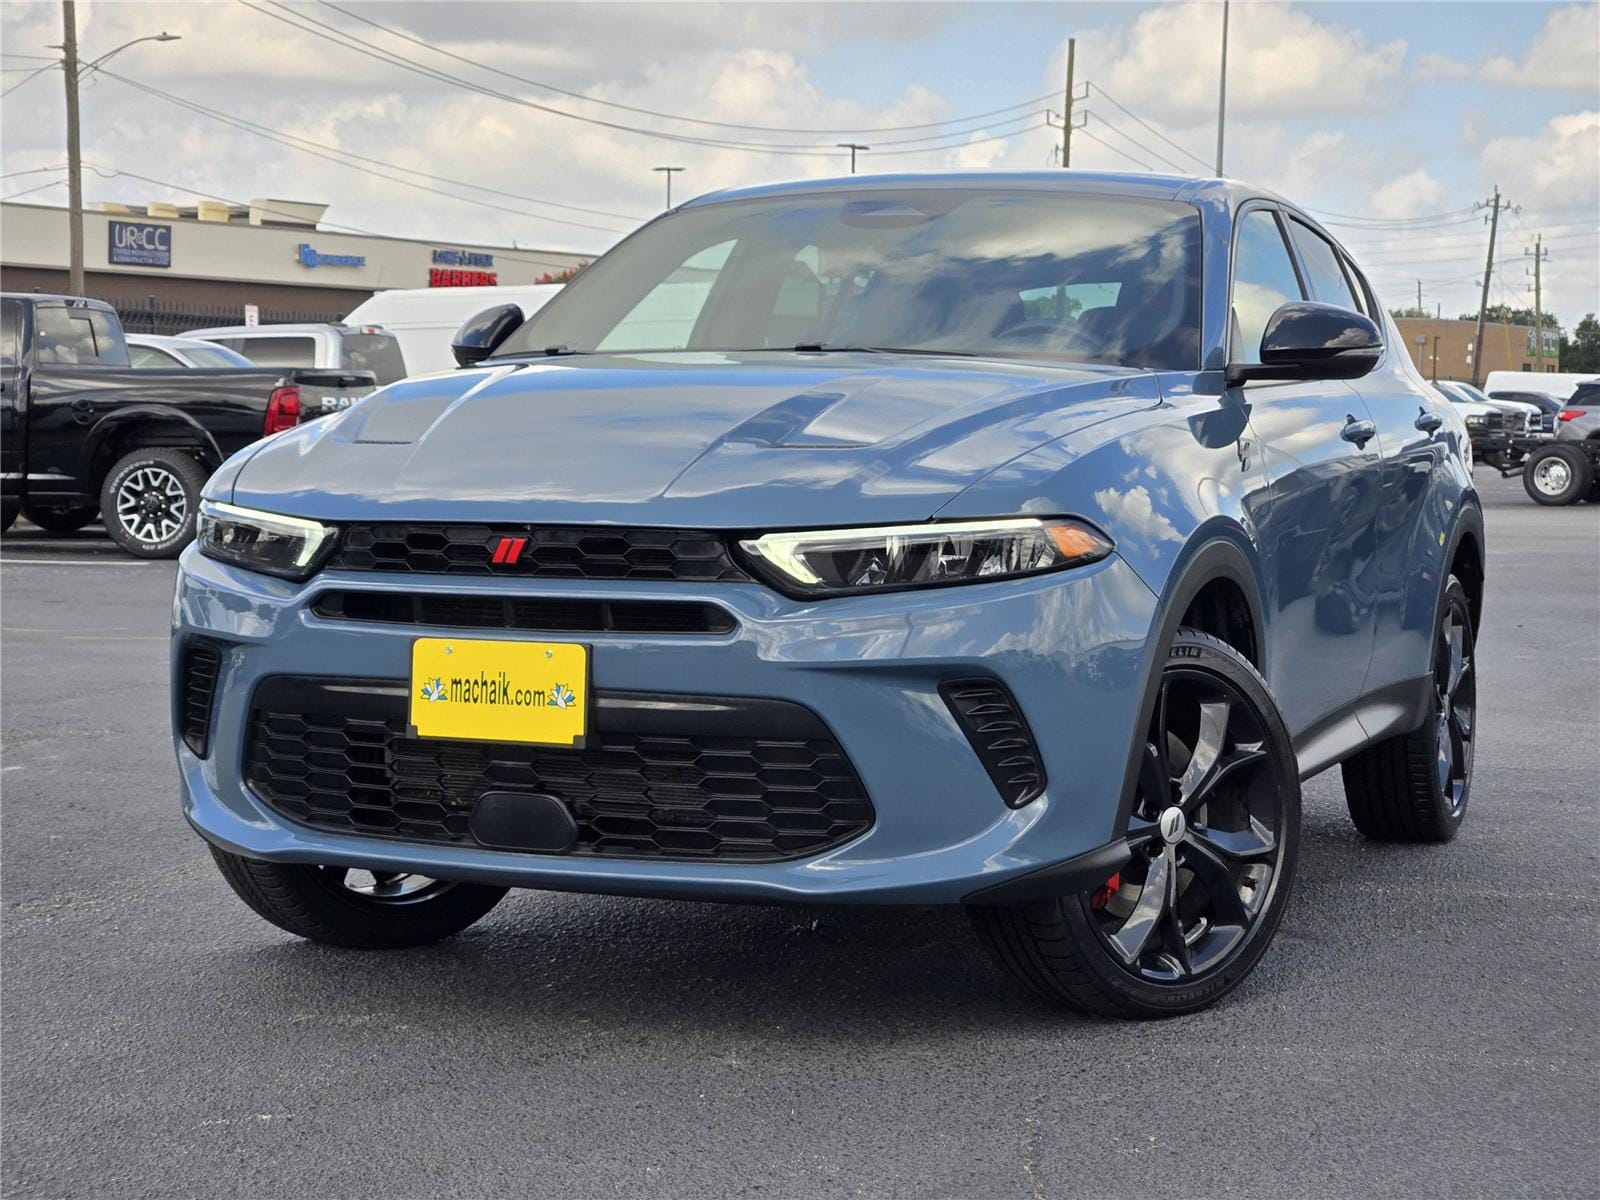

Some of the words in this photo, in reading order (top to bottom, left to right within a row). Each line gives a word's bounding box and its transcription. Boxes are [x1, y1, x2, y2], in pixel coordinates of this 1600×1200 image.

[429, 267, 497, 288] BARBERS
[1170, 646, 1199, 657] ELIN
[450, 671, 546, 707] machaik.com
